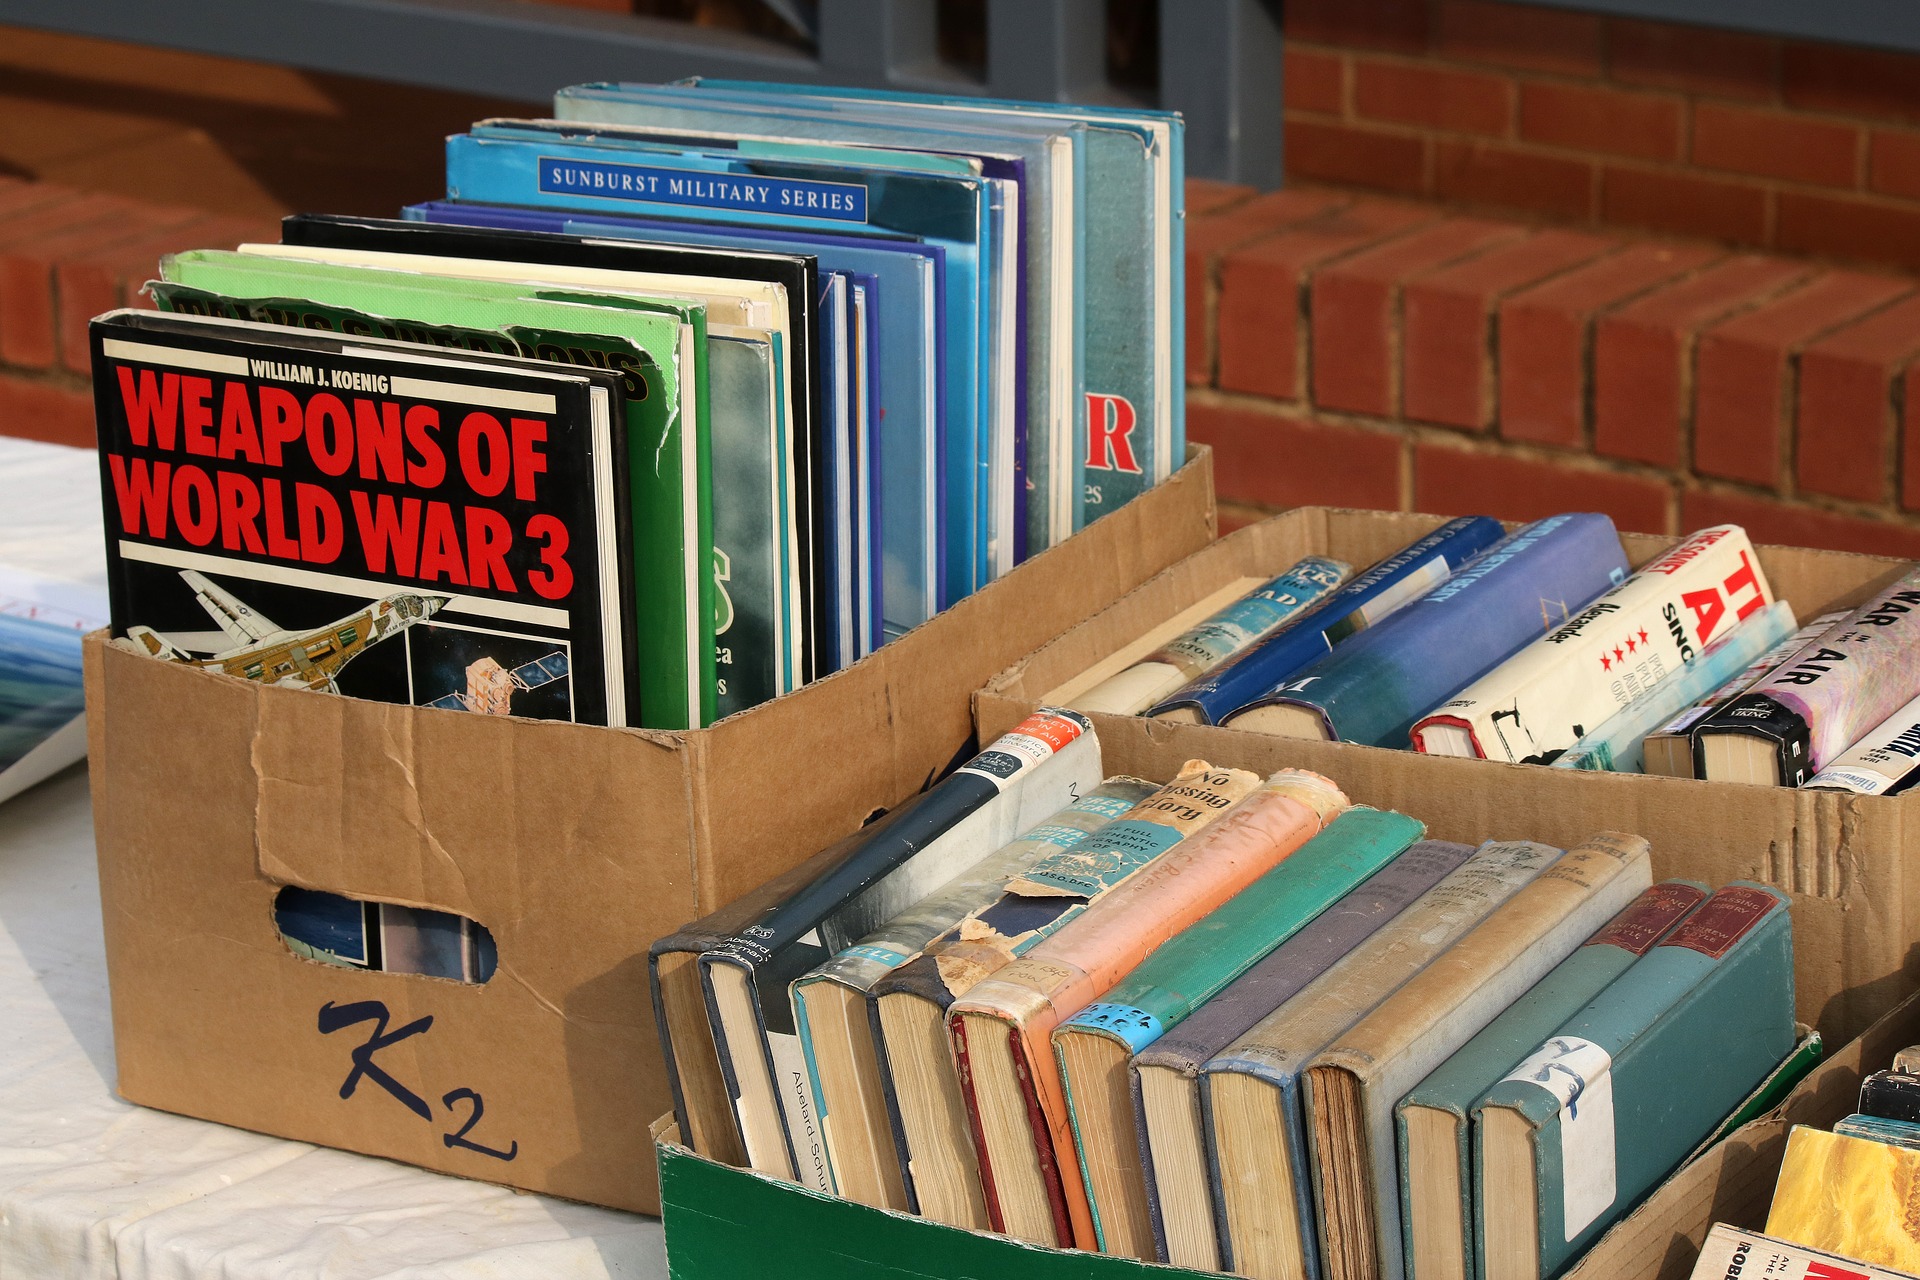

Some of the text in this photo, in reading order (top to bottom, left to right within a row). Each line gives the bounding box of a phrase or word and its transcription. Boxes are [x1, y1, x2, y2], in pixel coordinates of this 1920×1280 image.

[553, 168, 855, 211] SUNBURST MILITARY SERIES
[251, 359, 390, 395] WILLIAM J. KOENIG
[116, 365, 548, 501] WEAPONS OF
[1084, 392, 1143, 474] R
[109, 453, 575, 600] WORLD WAR 3
[1648, 545, 1706, 575] SOVIET
[1545, 602, 1622, 645] Alexander
[1773, 648, 1848, 685] AIR
[716, 678, 727, 695] s
[1730, 710, 1771, 719] VIKING
[1038, 723, 1051, 731] IN
[1003, 735, 1047, 754] Maurice
[1040, 732, 1061, 746] AIR
[999, 740, 1041, 758] Allward
[1203, 771, 1230, 786] No
[1124, 827, 1152, 838] FULL
[1712, 903, 1749, 914] GLORY
[1714, 897, 1760, 910] PASSING
[722, 937, 770, 954] Abelard
[1765, 1253, 1781, 1275] THE
[1778, 1255, 1790, 1273] AN
